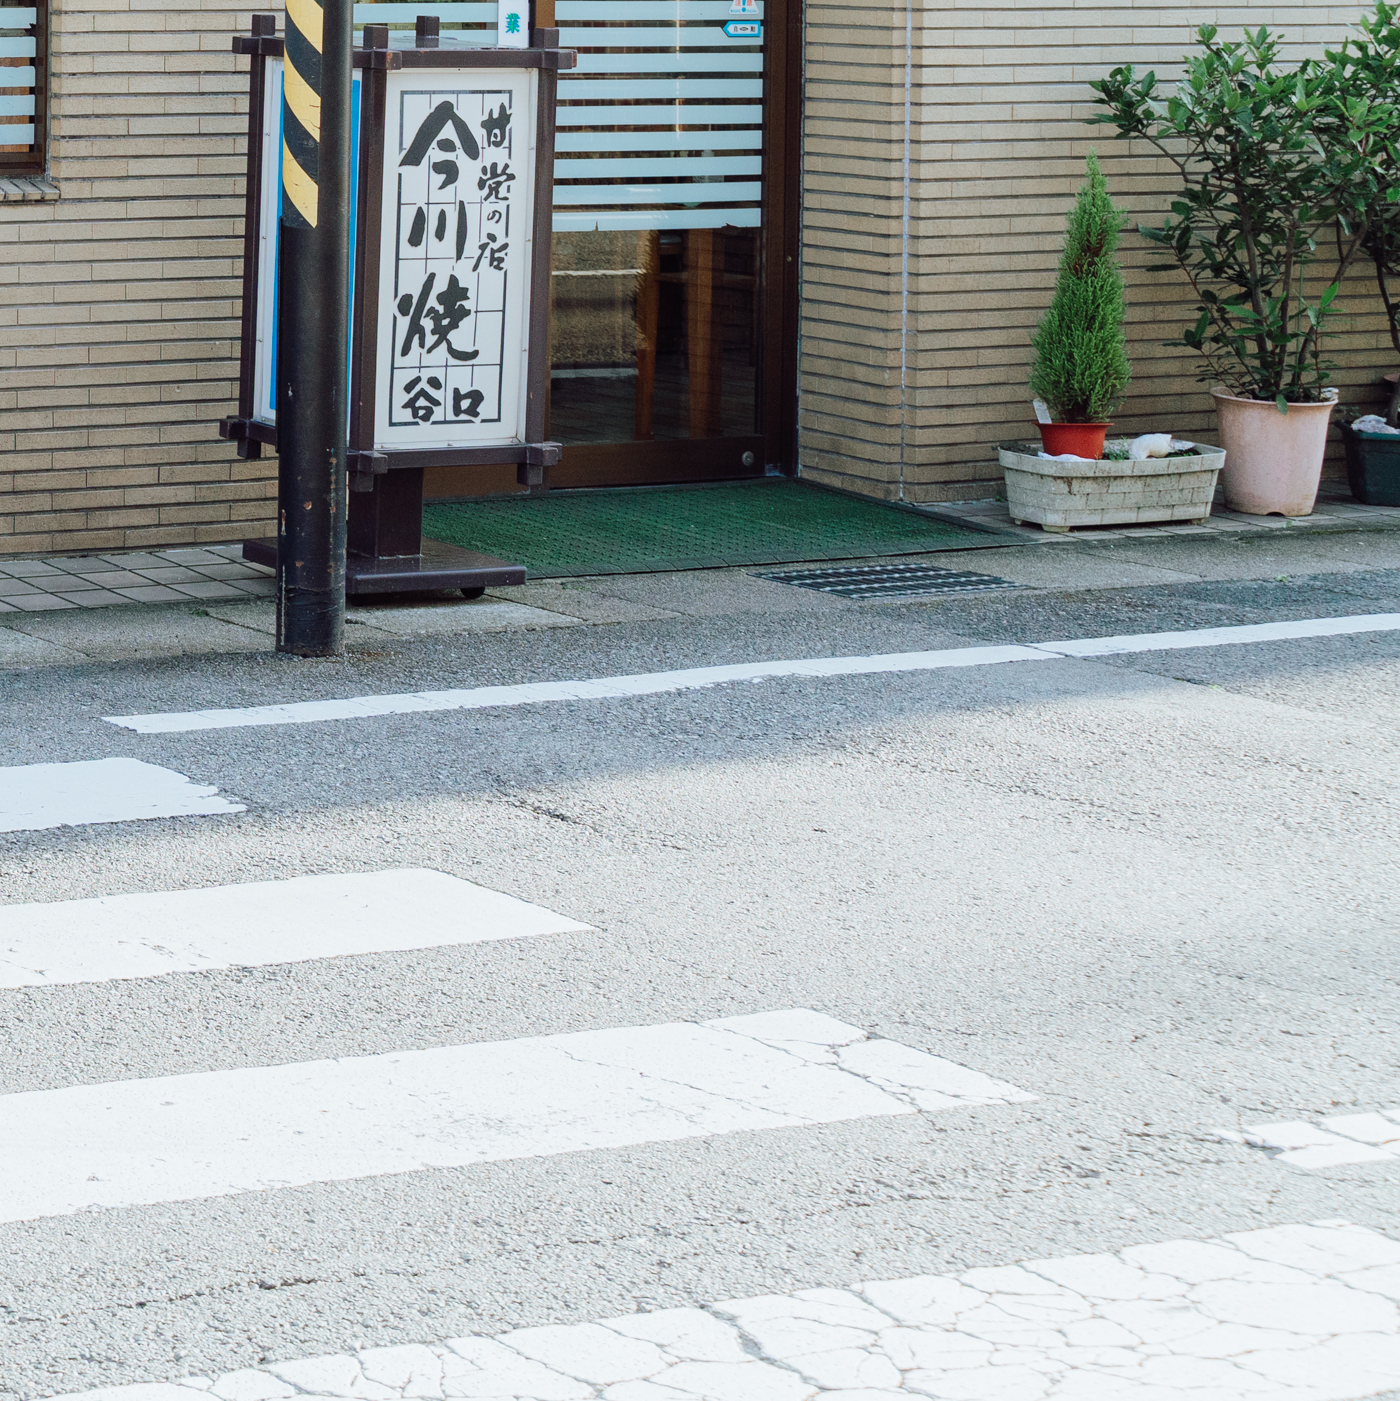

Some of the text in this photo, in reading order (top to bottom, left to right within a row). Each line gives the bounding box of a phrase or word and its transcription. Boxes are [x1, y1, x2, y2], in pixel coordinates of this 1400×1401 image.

[398, 100, 481, 361] 今川焼
[472, 102, 516, 273] 甘党の店
[402, 375, 485, 423] 谷口
